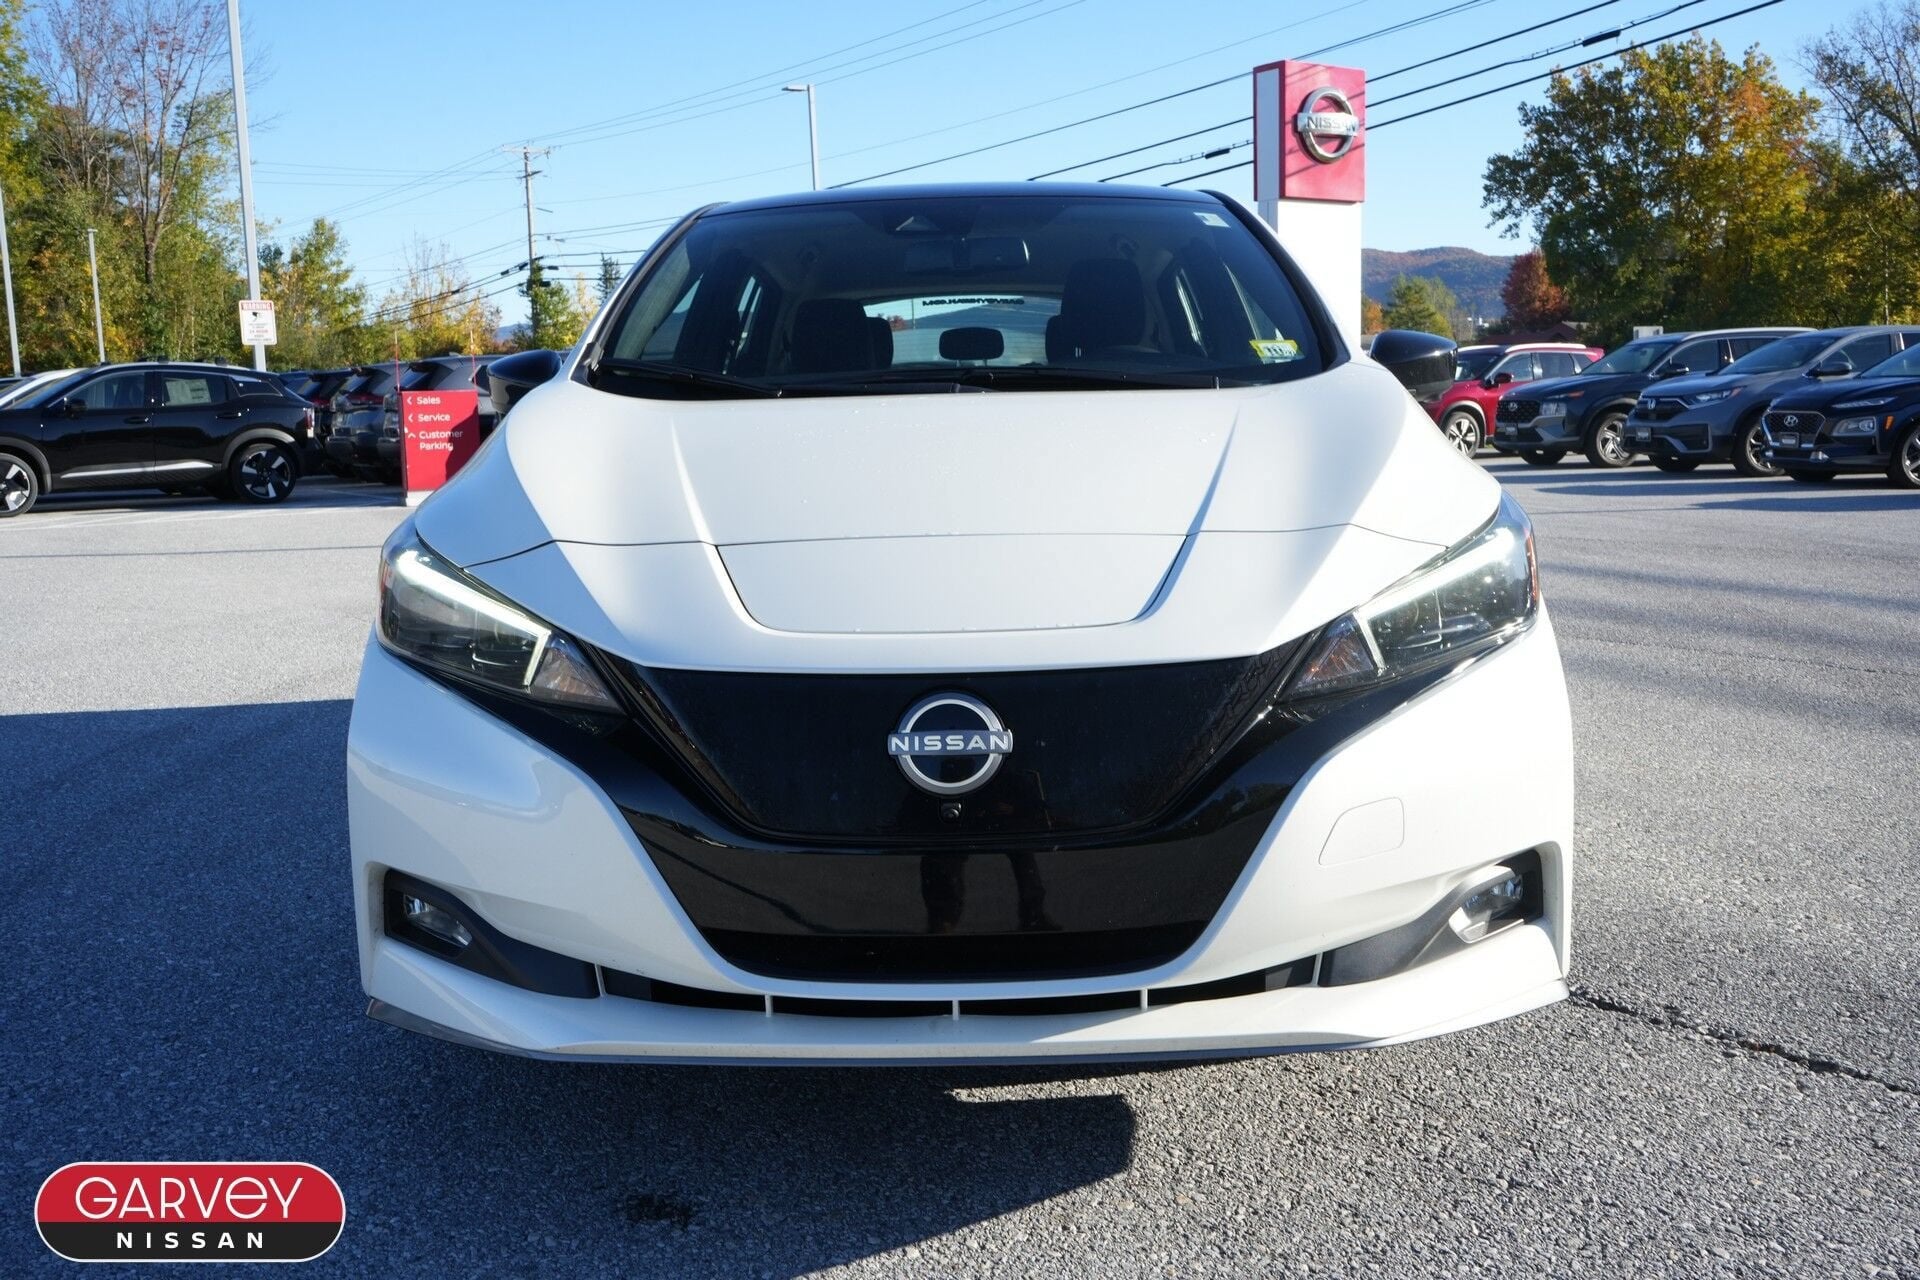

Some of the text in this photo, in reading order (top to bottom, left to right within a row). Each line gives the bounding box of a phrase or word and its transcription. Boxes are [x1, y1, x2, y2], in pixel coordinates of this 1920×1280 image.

[1306, 116, 1356, 132] NISSAN
[416, 396, 441, 405] Sales
[417, 413, 451, 422] Service
[418, 430, 463, 440] Customer
[419, 441, 454, 452] Parking
[891, 735, 1009, 751] NISSAN
